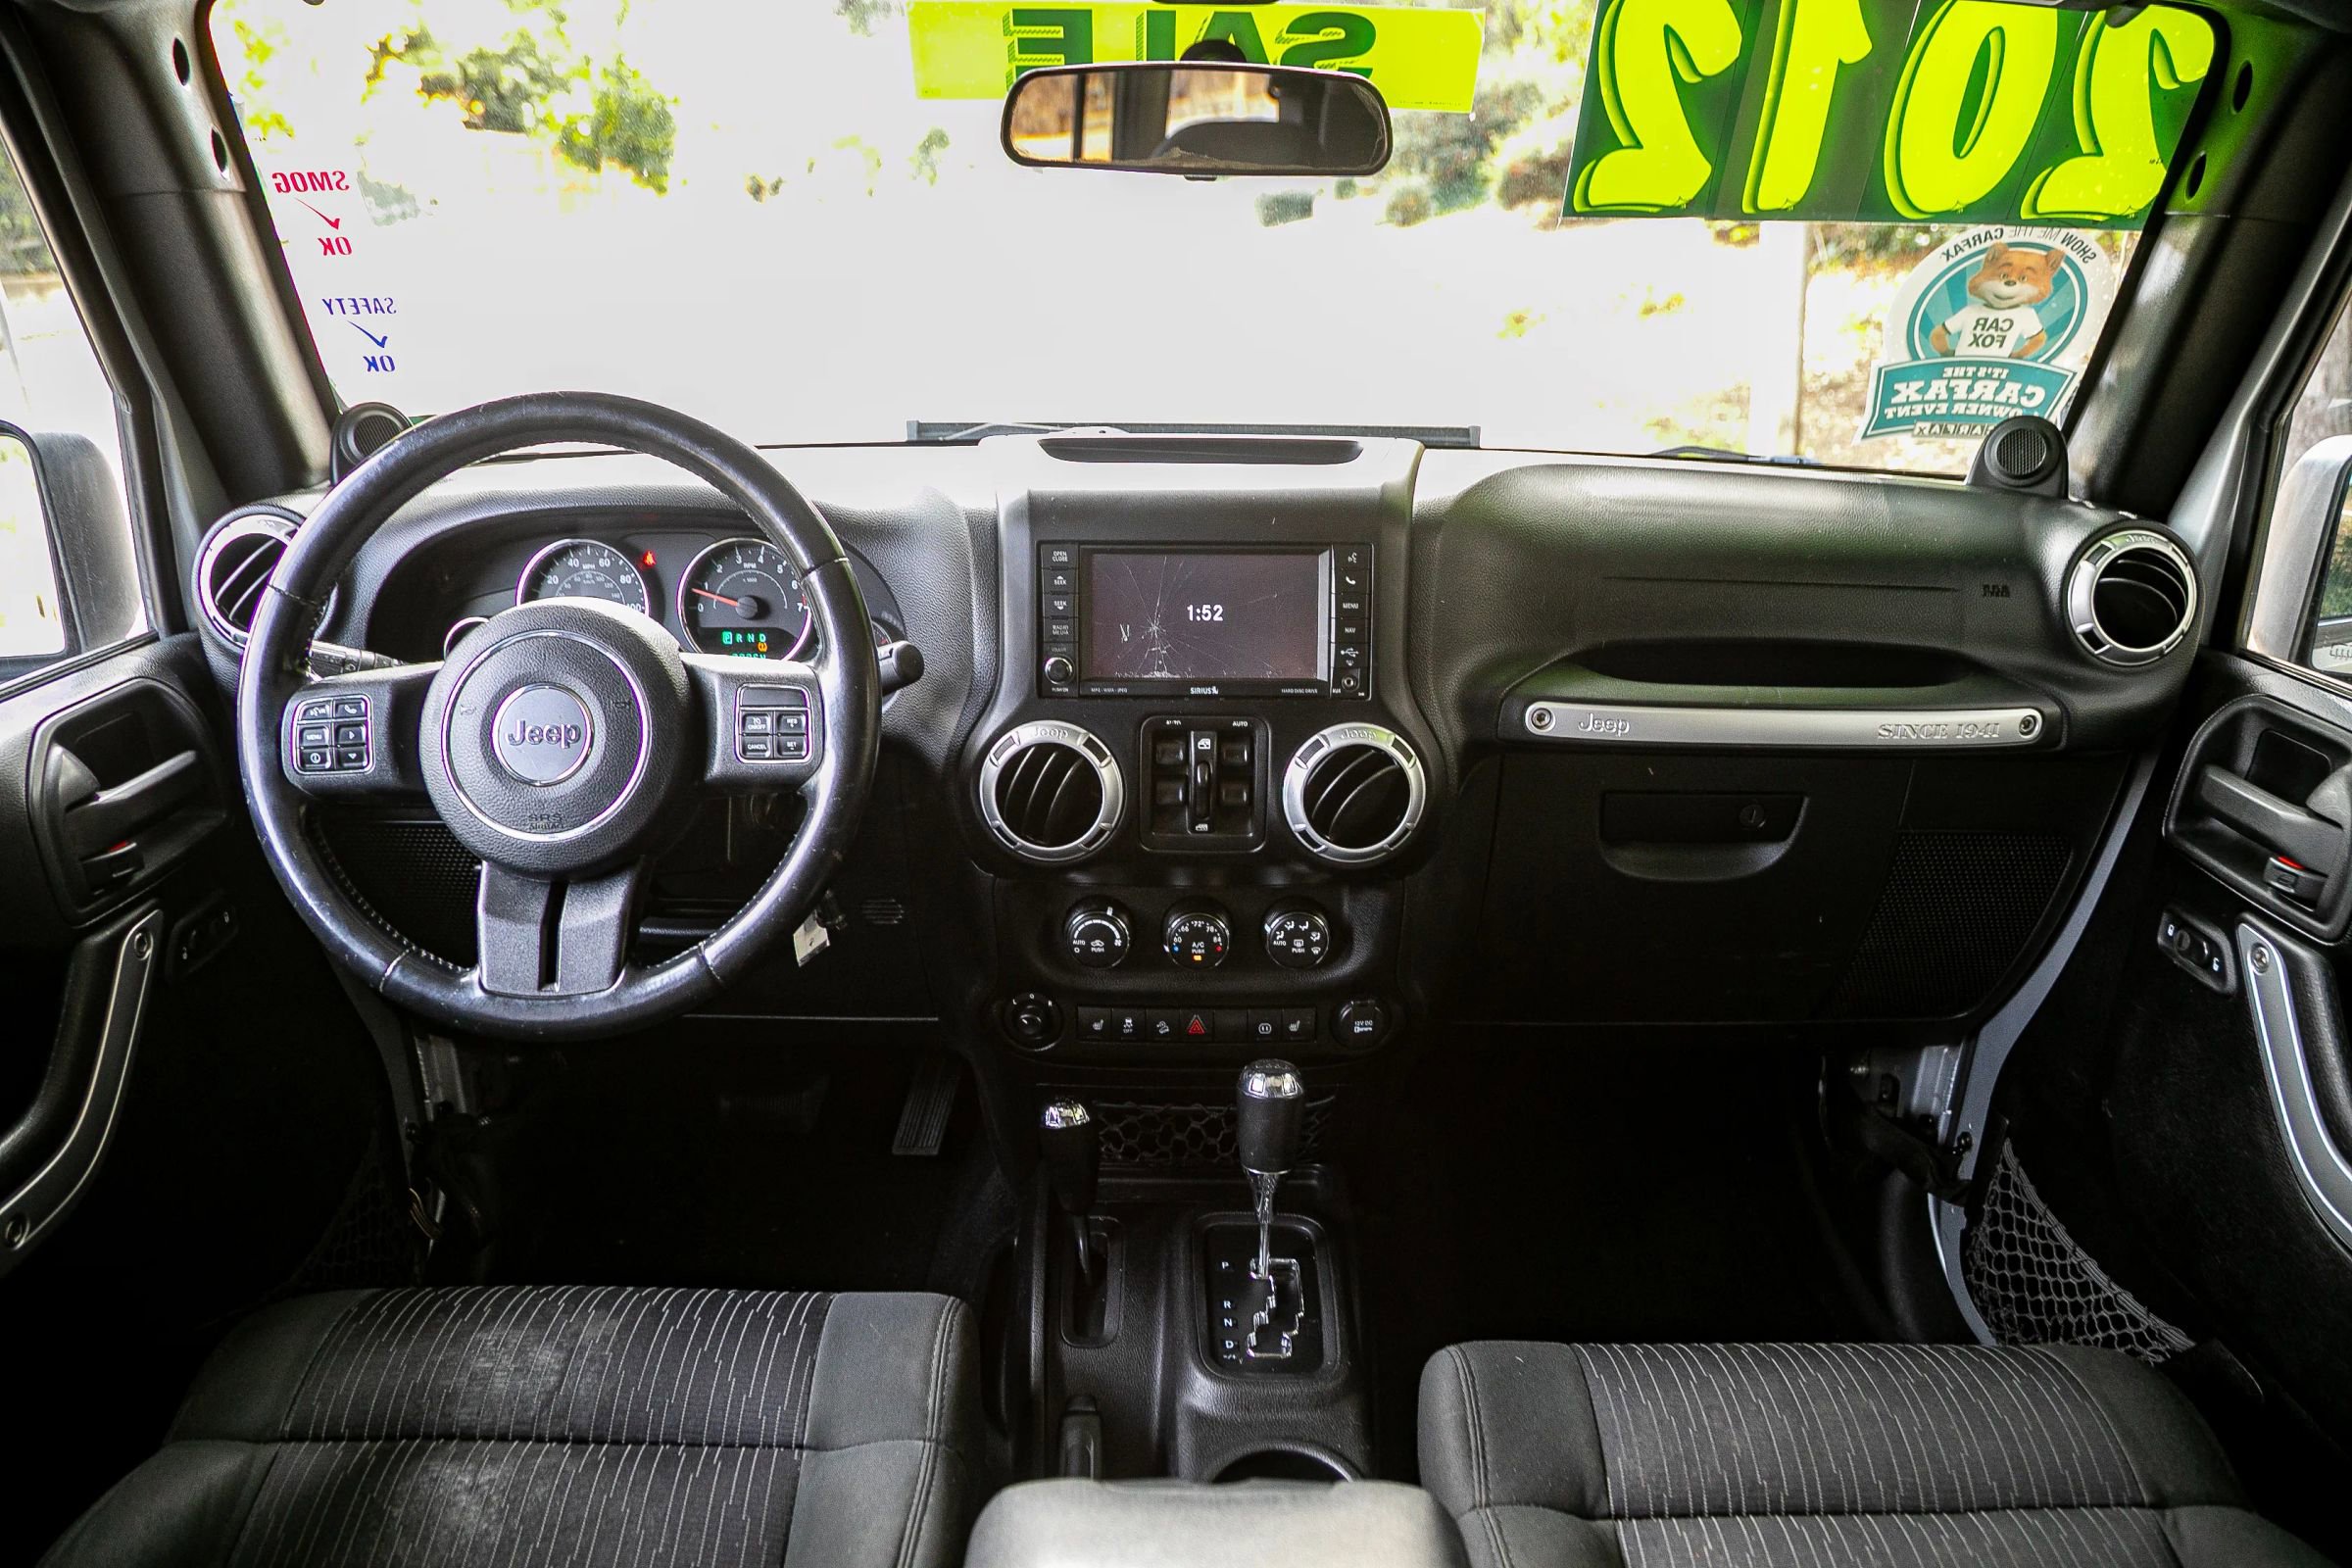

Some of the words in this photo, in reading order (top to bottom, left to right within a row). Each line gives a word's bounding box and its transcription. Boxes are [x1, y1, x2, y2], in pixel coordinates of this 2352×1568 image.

[567, 558, 580, 567] 40
[598, 558, 611, 567] 60
[735, 555, 743, 564] 3
[758, 555, 764, 564] 4
[716, 564, 723, 573] 2
[776, 564, 784, 574] 5
[547, 574, 560, 585] 20
[619, 574, 632, 584] 80
[791, 580, 798, 589] 6
[697, 604, 705, 612] 0
[797, 603, 803, 612] 7
[1187, 604, 1224, 621] 1:52
[735, 632, 743, 643] R
[747, 632, 755, 643] N
[759, 632, 766, 643] D
[1190, 686, 1212, 695] SIRIUS
[1577, 712, 1631, 737] Jeep
[505, 719, 582, 749] Jeep
[1034, 725, 1069, 740] Jeep
[1878, 723, 1948, 739] SINCE
[1955, 723, 2000, 739] 1941
[1223, 1300, 1232, 1309] R
[1224, 1318, 1233, 1327] N
[1225, 1340, 1235, 1349] D
